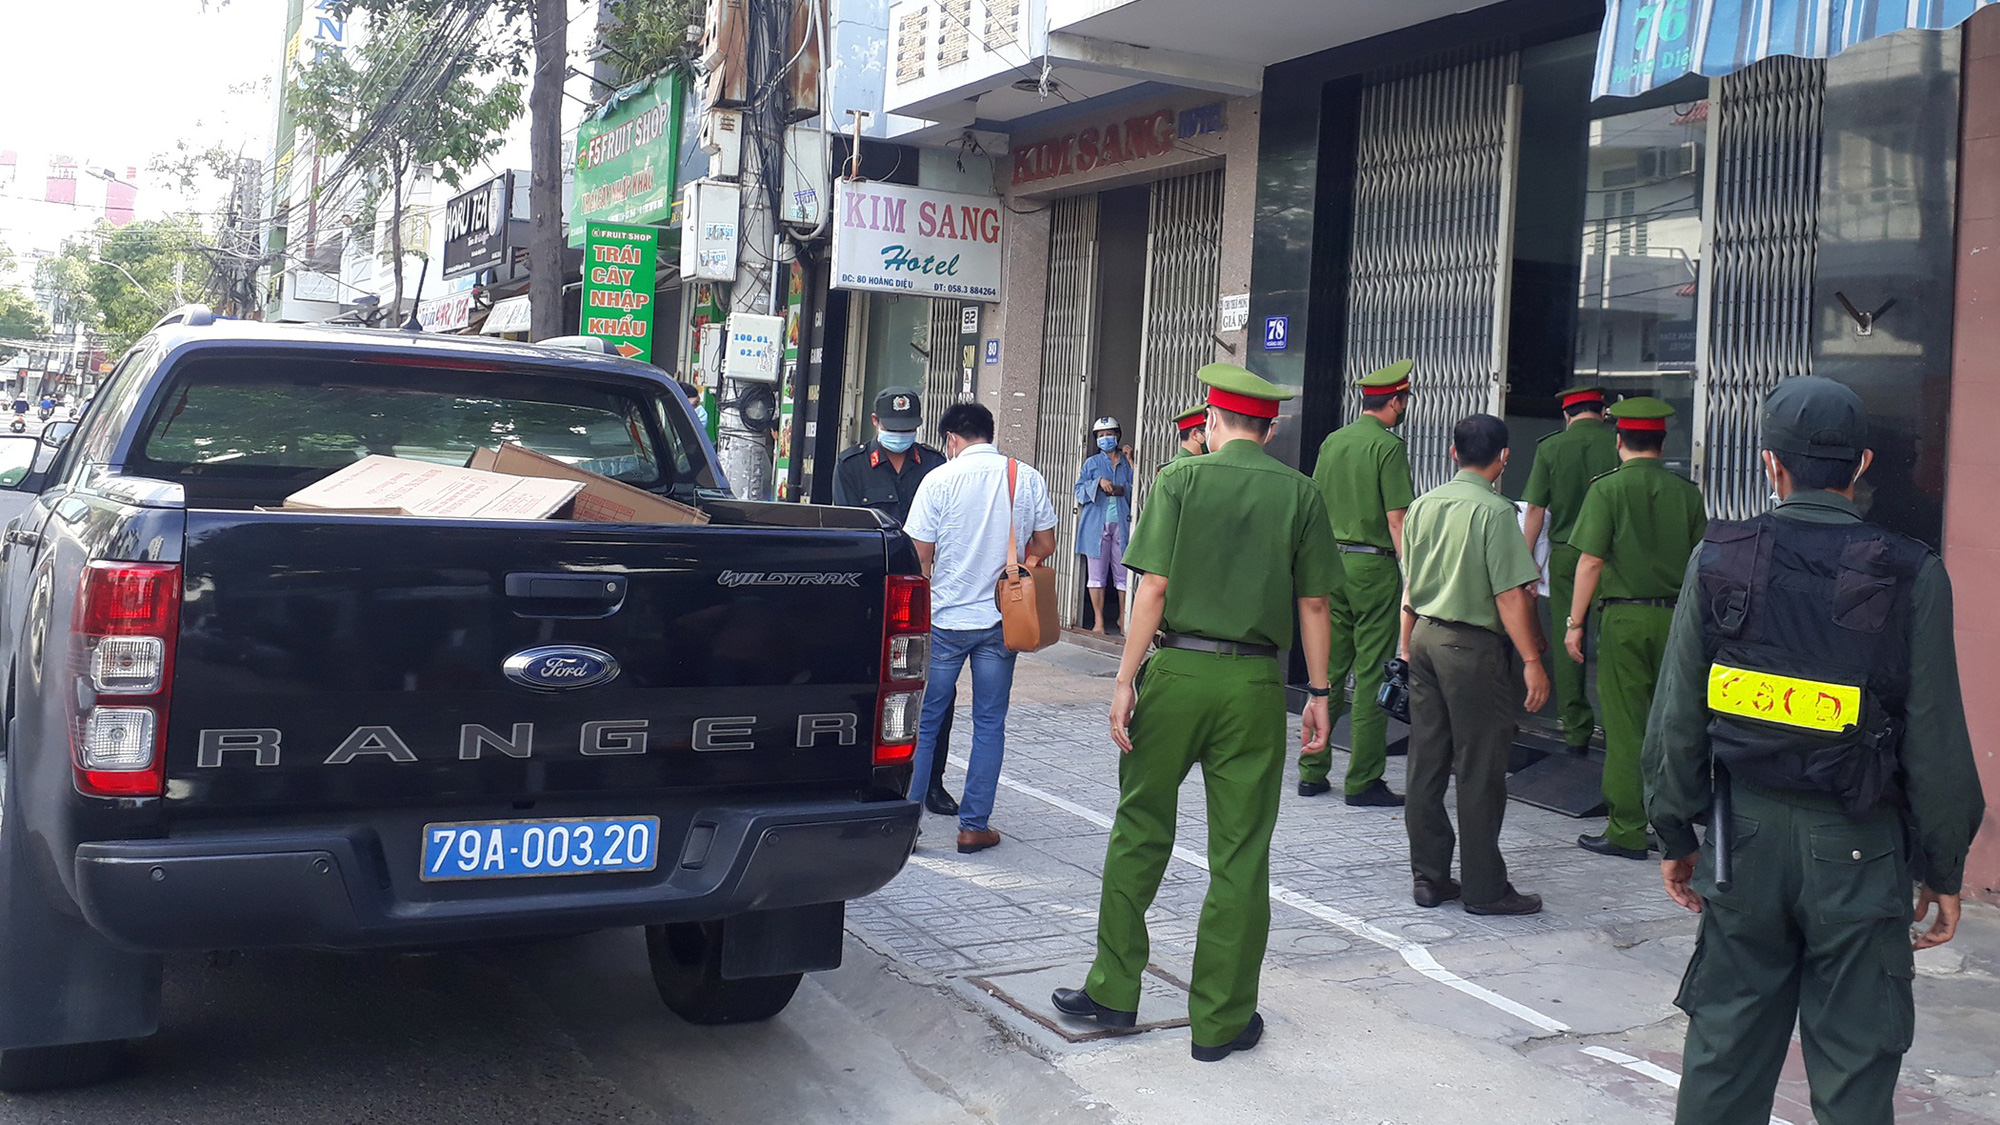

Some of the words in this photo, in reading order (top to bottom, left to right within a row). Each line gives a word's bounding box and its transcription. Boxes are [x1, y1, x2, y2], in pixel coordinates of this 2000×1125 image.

[1633, 0, 1687, 50] 76
[634, 101, 668, 149] SHOP
[1012, 133, 1076, 185] KIM
[1076, 109, 1175, 173] SANG
[844, 192, 907, 233] KIM
[918, 201, 1000, 243] SANG
[601, 230, 627, 240] FRUIT
[628, 232, 652, 241] SHOP
[593, 244, 641, 265] TRÁI
[881, 245, 960, 276] Hotel
[591, 265, 634, 286] CÂY
[857, 275, 867, 284] 80
[869, 276, 894, 287] HOÀNG
[896, 278, 914, 289] DIỆU
[590, 289, 649, 312] NHẬP
[948, 284, 968, 294] 058.3
[970, 286, 996, 296] 884264
[588, 314, 647, 337] KHẨU
[963, 310, 976, 325] 82
[1223, 312, 1236, 328] GIÁ
[1268, 320, 1285, 340] 78
[987, 341, 997, 356] 80
[717, 570, 863, 587] WILDTRAK
[541, 657, 588, 678] Ford
[197, 712, 858, 768] RANGER
[431, 823, 649, 873] 79A-003.20
